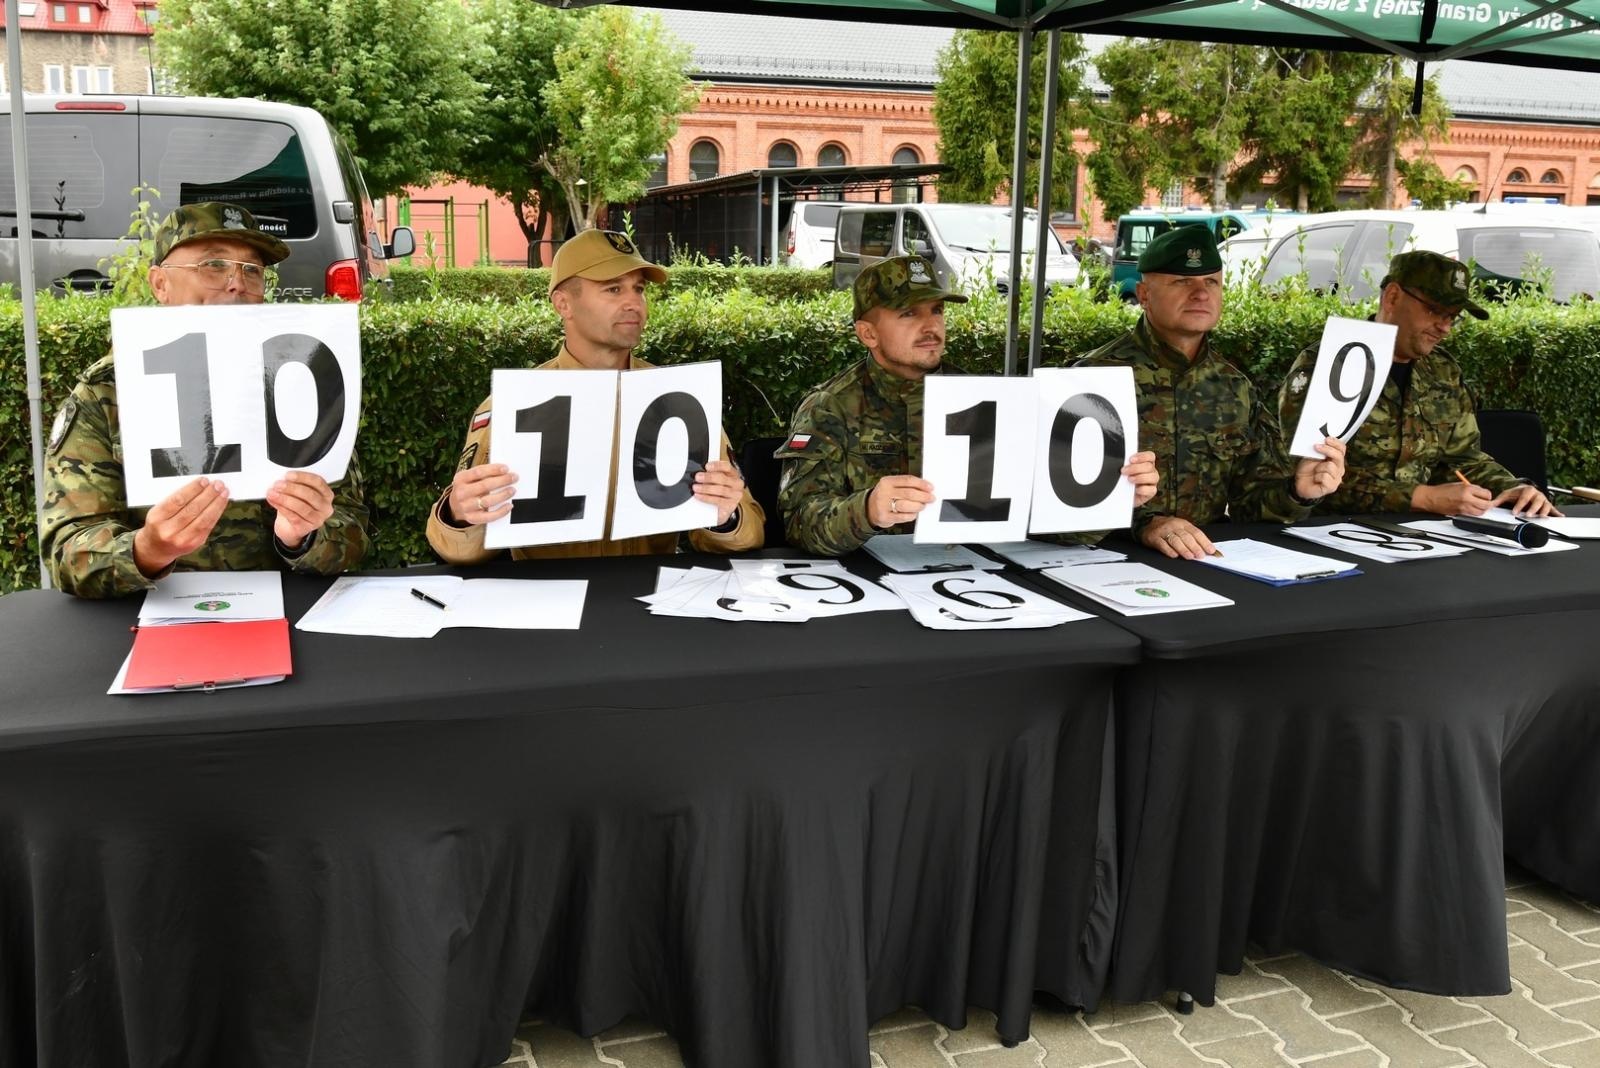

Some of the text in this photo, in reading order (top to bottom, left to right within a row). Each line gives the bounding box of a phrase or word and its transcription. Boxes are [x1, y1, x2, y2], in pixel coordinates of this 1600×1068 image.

[259, 222, 287, 231] dności
[142, 332, 346, 479] 10
[1318, 341, 1376, 440] 9
[510, 391, 710, 525] 10
[938, 392, 1126, 523] 10
